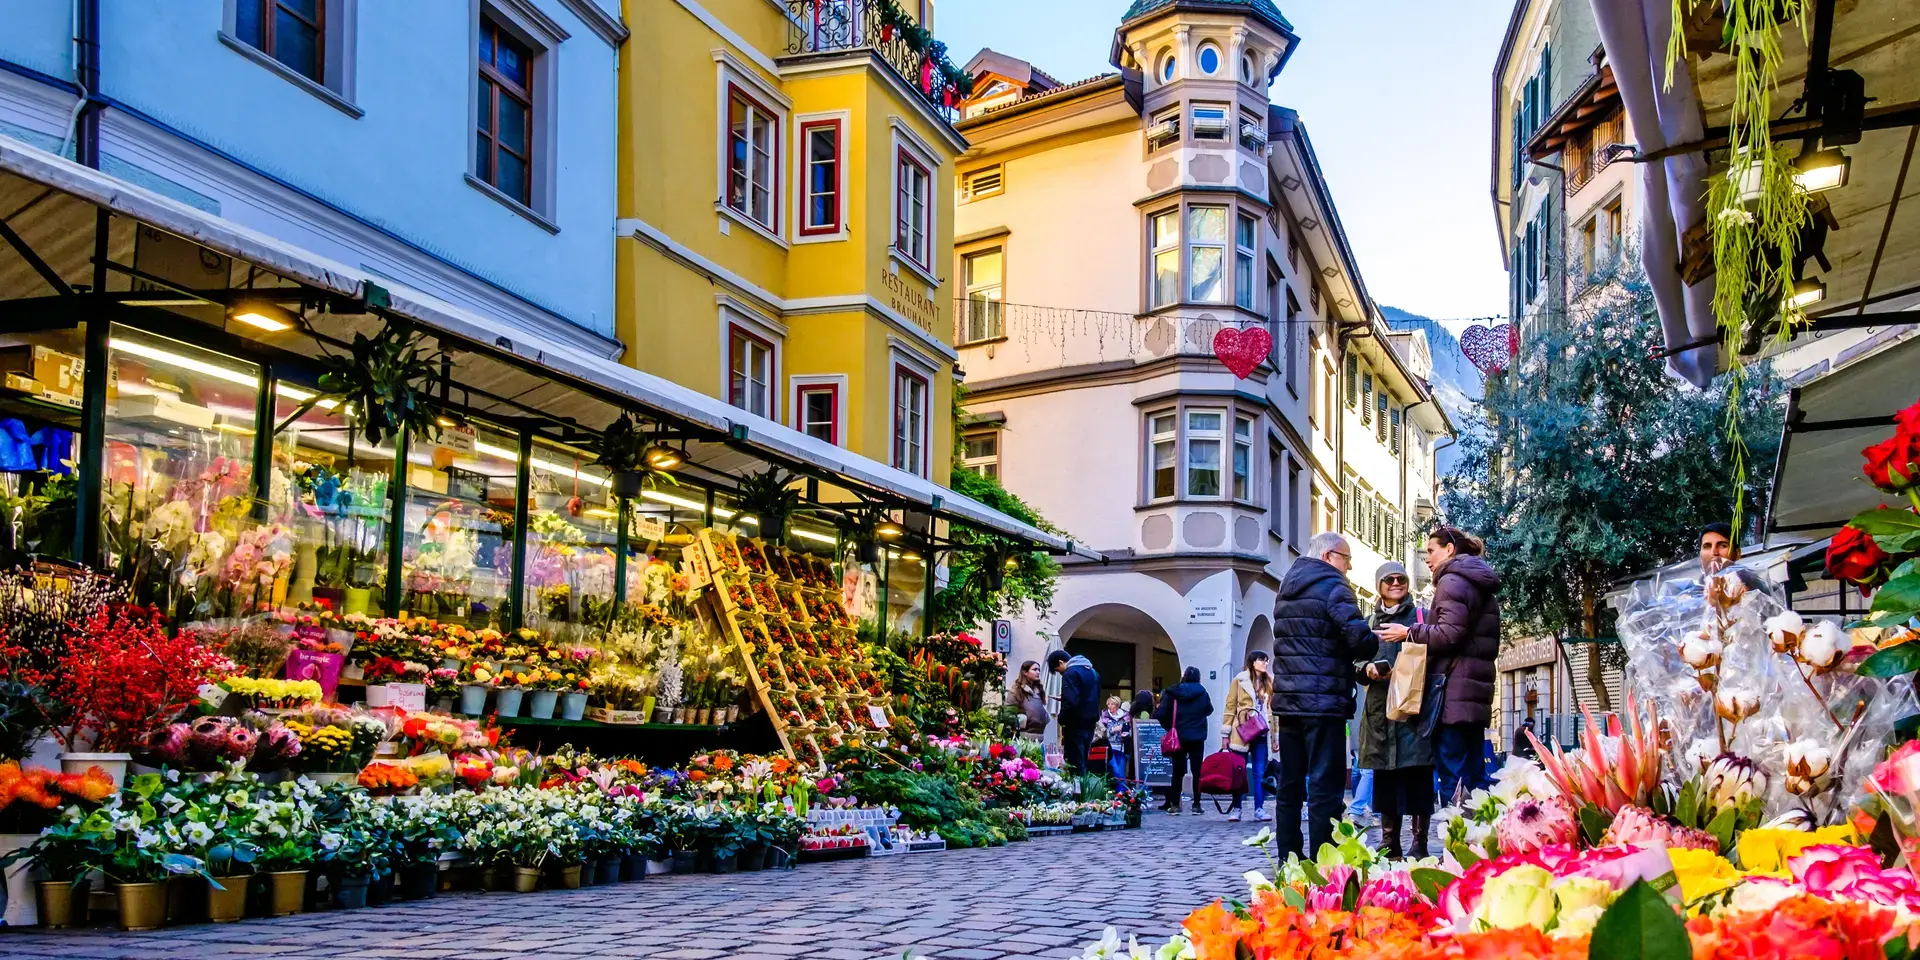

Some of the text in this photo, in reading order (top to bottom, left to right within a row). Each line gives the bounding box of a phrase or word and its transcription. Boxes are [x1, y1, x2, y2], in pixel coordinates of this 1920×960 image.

[881, 268, 941, 322] RESTAURANT
[891, 297, 932, 333] BRAUHAUS
[299, 652, 330, 663] be magic
